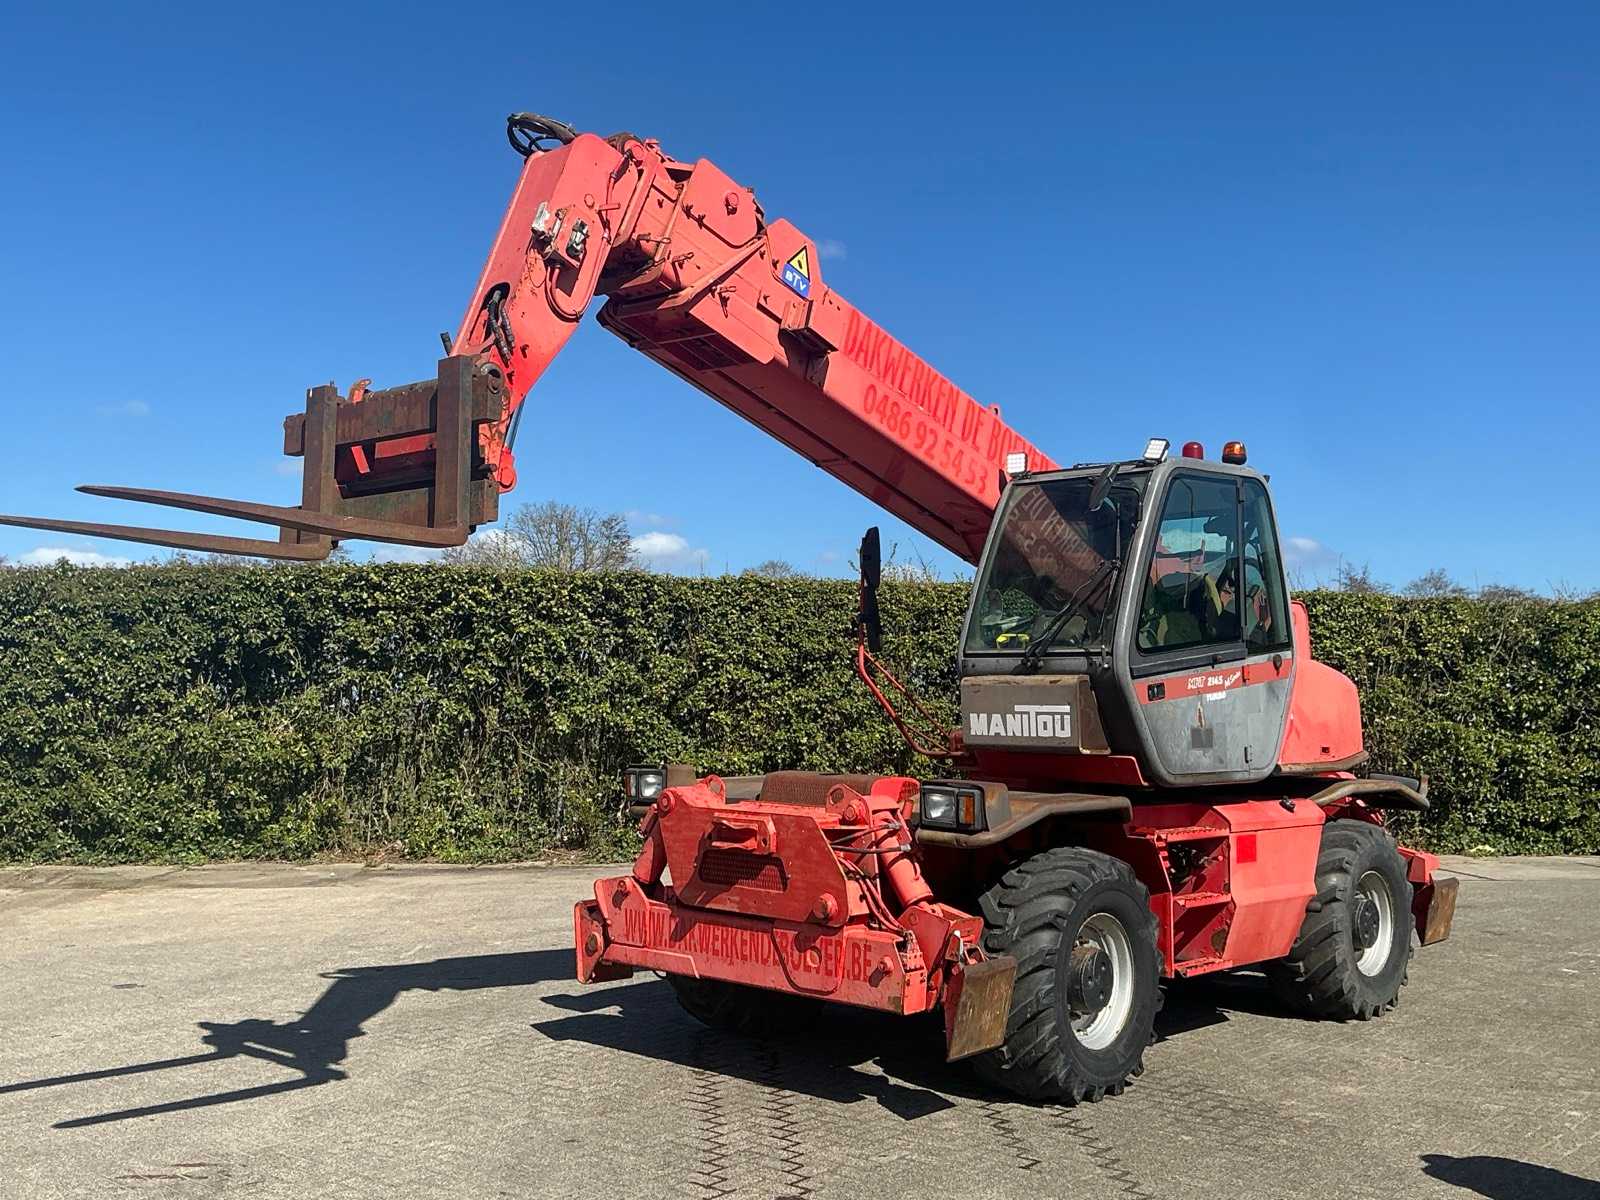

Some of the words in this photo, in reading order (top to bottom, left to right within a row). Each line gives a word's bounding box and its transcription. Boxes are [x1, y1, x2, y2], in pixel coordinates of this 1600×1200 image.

[843, 309, 960, 433] DAKWERKEN
[961, 399, 987, 453] DE
[863, 384, 912, 439] 0486
[914, 421, 938, 460] 92
[941, 440, 964, 477] 54
[964, 459, 988, 494] 53
[969, 704, 1072, 737] MANITOU
